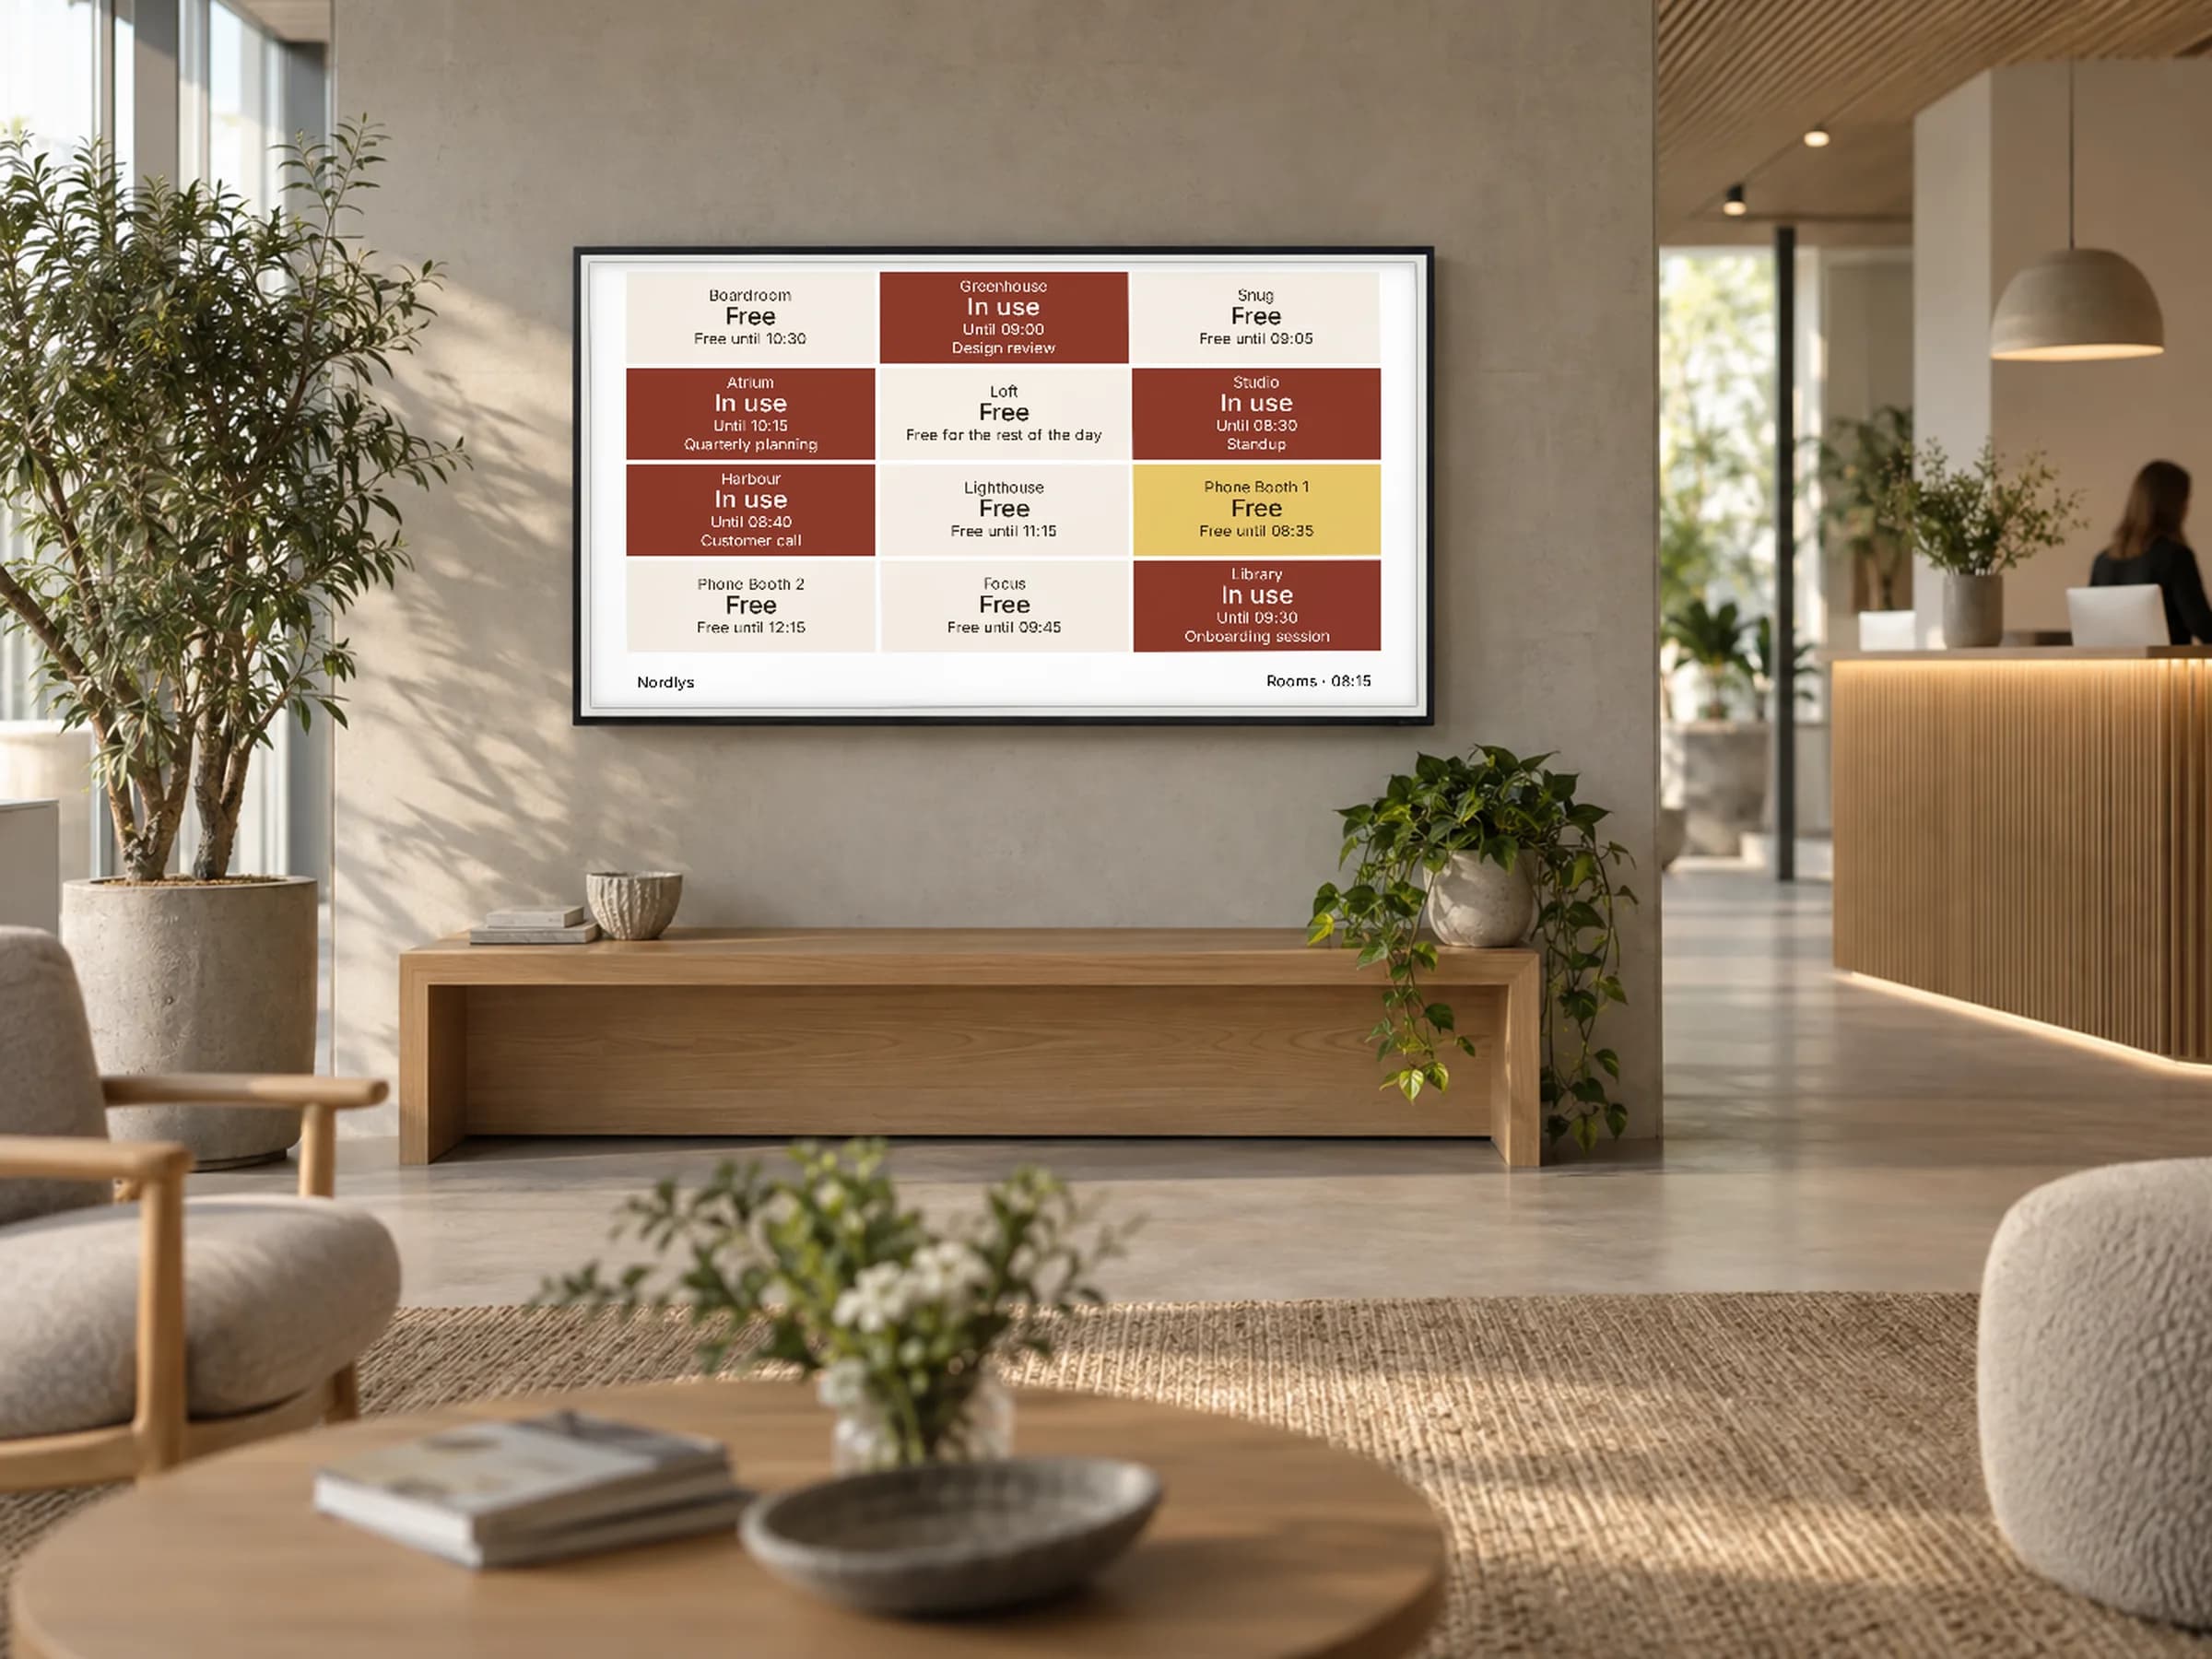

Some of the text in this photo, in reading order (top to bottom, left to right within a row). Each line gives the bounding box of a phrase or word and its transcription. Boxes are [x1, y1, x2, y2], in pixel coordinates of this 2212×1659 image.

[959, 279, 1048, 293] Greenhouse
[709, 288, 792, 302] Boardroom
[1238, 288, 1275, 305] Snug
[968, 297, 1041, 317] In use
[726, 306, 777, 326] Free
[1231, 306, 1282, 326] Free
[962, 323, 1045, 336] Until 09:00
[694, 332, 807, 345] Free until 10:30
[1199, 332, 1313, 345] Free until 09:05
[952, 341, 1056, 358] Design review
[726, 376, 774, 390] Atrium
[1233, 375, 1280, 389] Studio
[990, 383, 1018, 398] Loft
[715, 393, 788, 414] In use
[1220, 393, 1294, 413] In use
[980, 402, 1030, 423] Free
[713, 418, 788, 432] Until 10:15
[1216, 418, 1299, 432] Until 08:30
[906, 428, 1103, 444] Free for the rest of the day
[683, 437, 818, 453] Quarterly planning
[1227, 437, 1287, 453] Standup
[722, 472, 782, 486] Harbour
[964, 480, 1045, 498] Lighthouse
[1205, 480, 1309, 495] Phone Booth 1
[715, 489, 788, 510] In use
[980, 498, 1030, 518] Free
[1231, 499, 1283, 518] Free
[711, 515, 793, 528] Until 08:40
[950, 524, 1057, 537] Free until 11:15
[1199, 524, 1315, 537] Free until 08:35
[700, 534, 802, 547] Customer call
[1231, 567, 1283, 583] Library
[698, 578, 805, 591] Phone Booth 2
[983, 576, 1027, 591] Focus
[1222, 584, 1294, 605] In use
[726, 594, 777, 616] Free
[980, 594, 1031, 614] Free
[1217, 610, 1299, 625] Until 09:30
[697, 620, 806, 634] Free until 12:15
[947, 620, 1062, 634] Free until 09:45
[1184, 629, 1330, 646] Onboarding session
[637, 676, 695, 692] Nordlys
[1266, 674, 1318, 688] Rooms
[1331, 674, 1371, 688] 08:15
